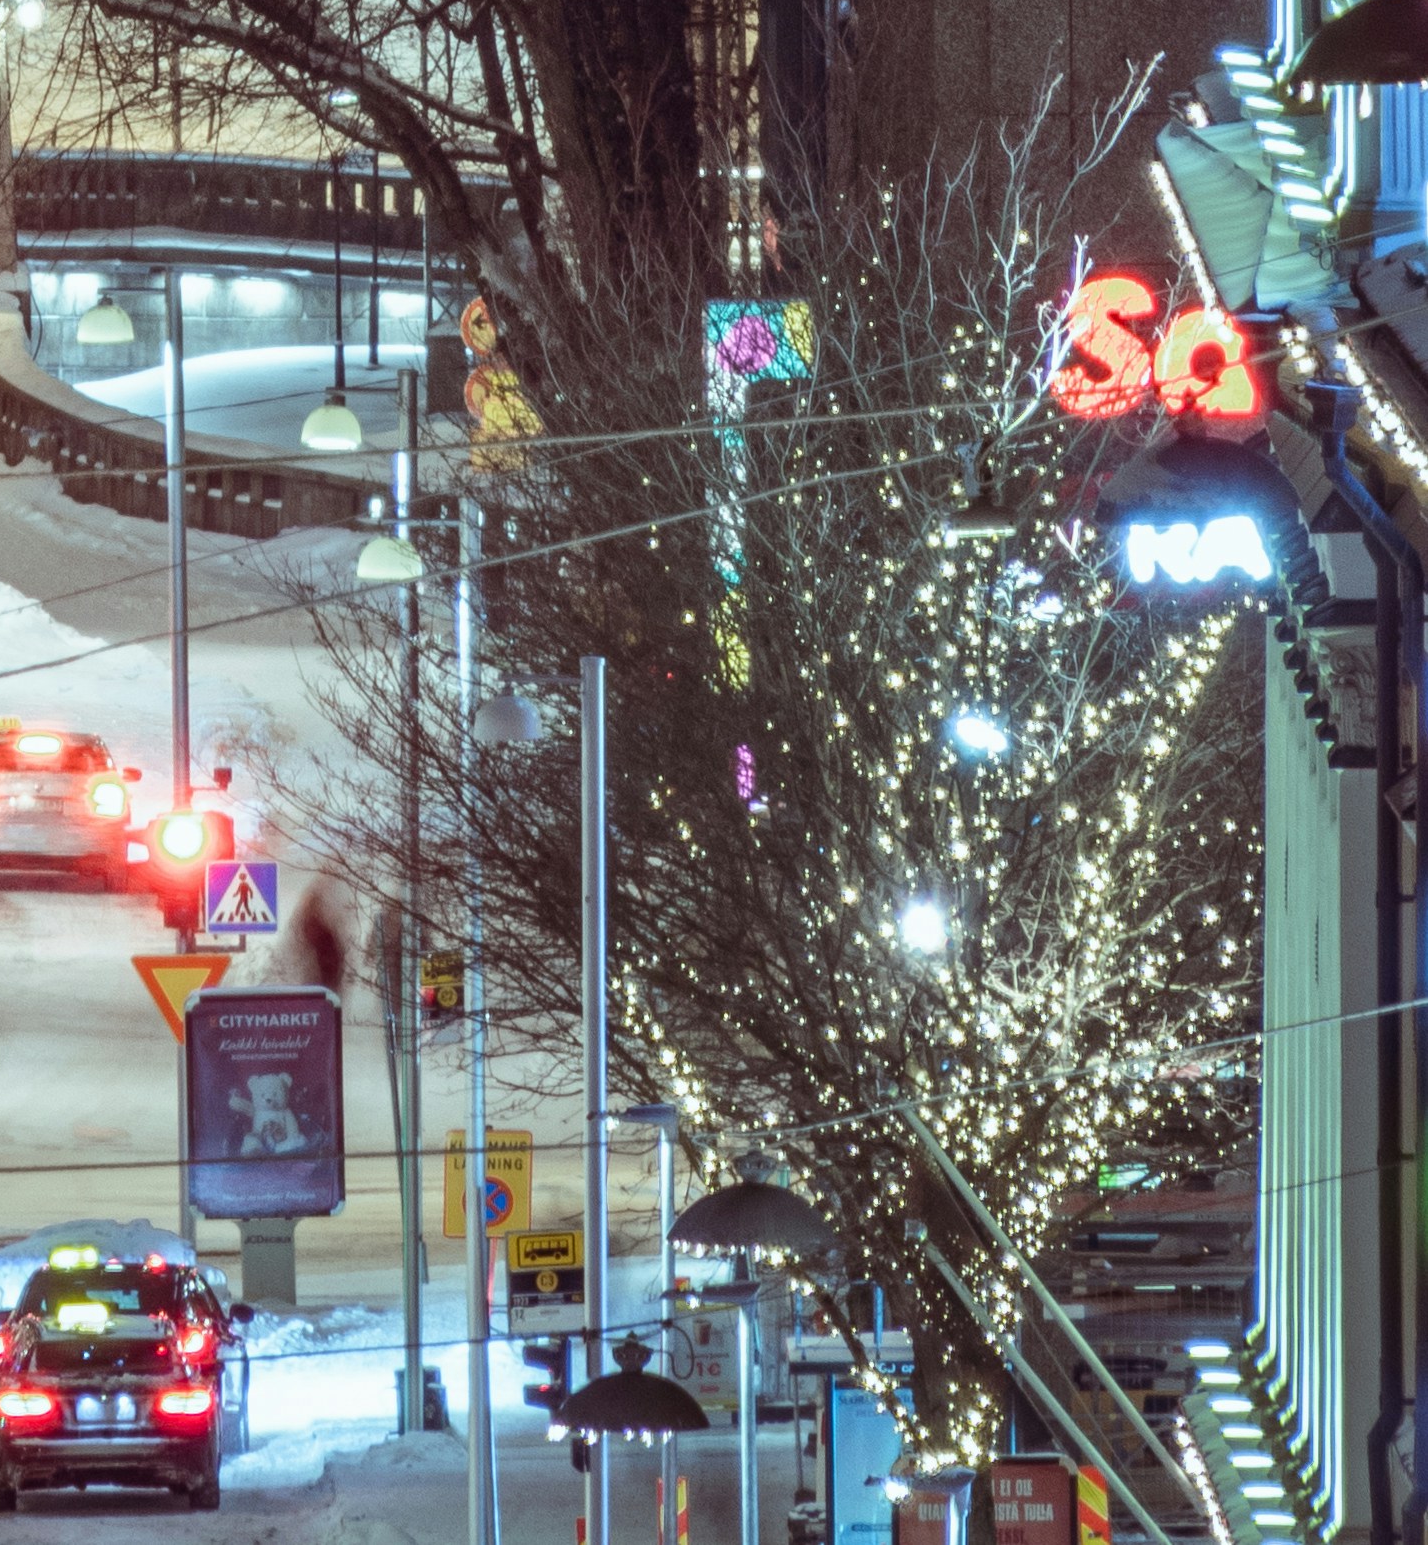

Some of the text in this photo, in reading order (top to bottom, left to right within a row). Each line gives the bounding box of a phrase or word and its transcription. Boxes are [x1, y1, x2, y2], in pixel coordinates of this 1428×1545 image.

[219, 1012, 320, 1029] CITYMARKET
[219, 1037, 257, 1051] Kaikki
[454, 1157, 523, 1171] LANING
